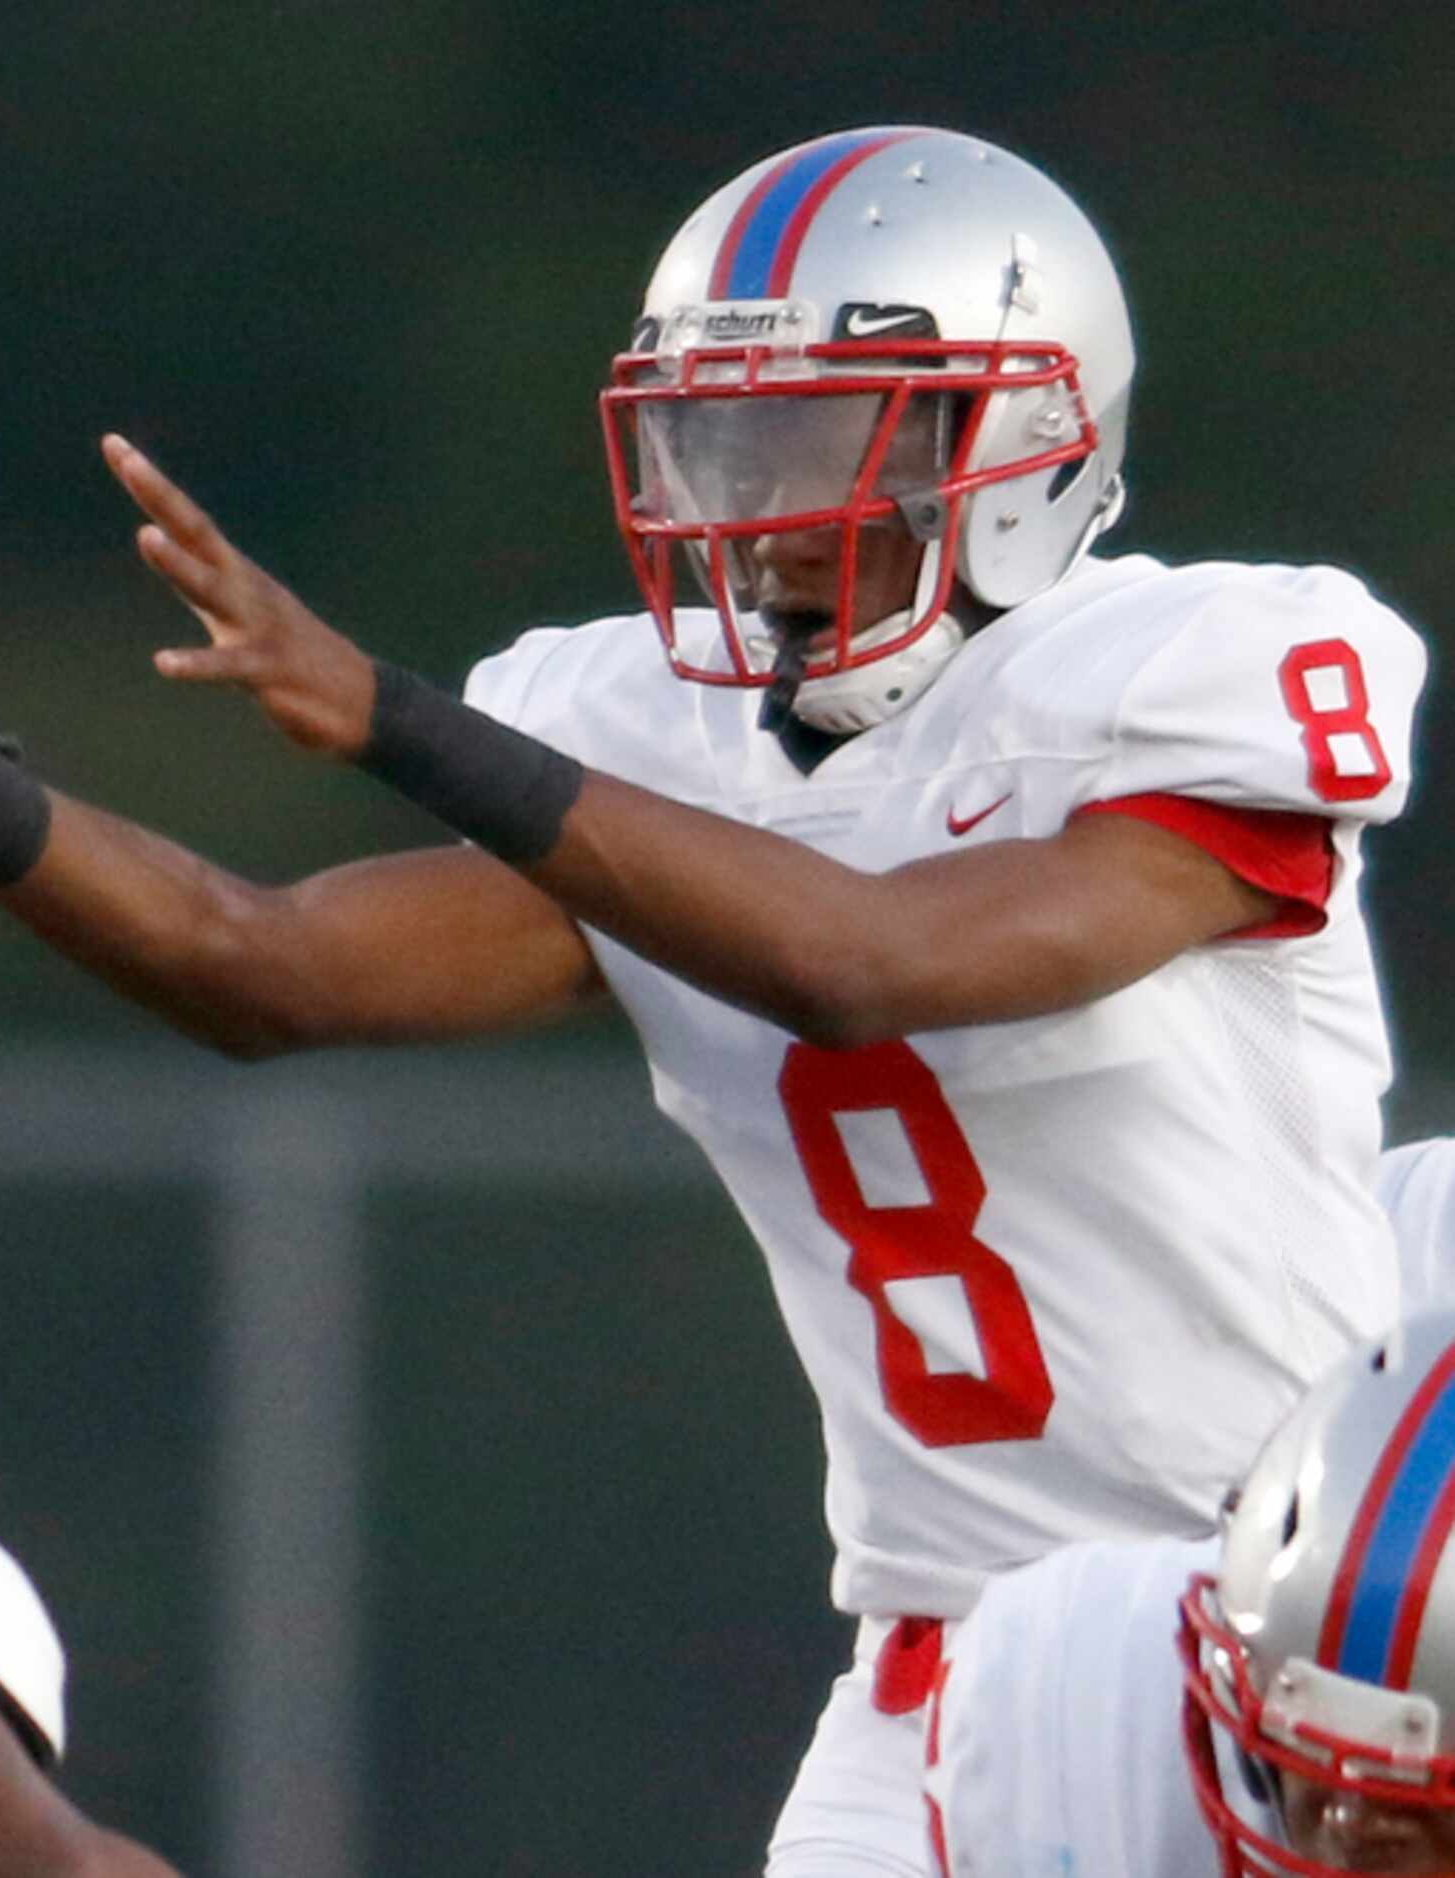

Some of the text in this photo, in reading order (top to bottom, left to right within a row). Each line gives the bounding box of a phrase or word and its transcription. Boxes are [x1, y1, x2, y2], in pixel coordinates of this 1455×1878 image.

[704, 309, 777, 333] schutt
[1277, 637, 1393, 804] 8
[777, 1037, 1055, 1449] 8
